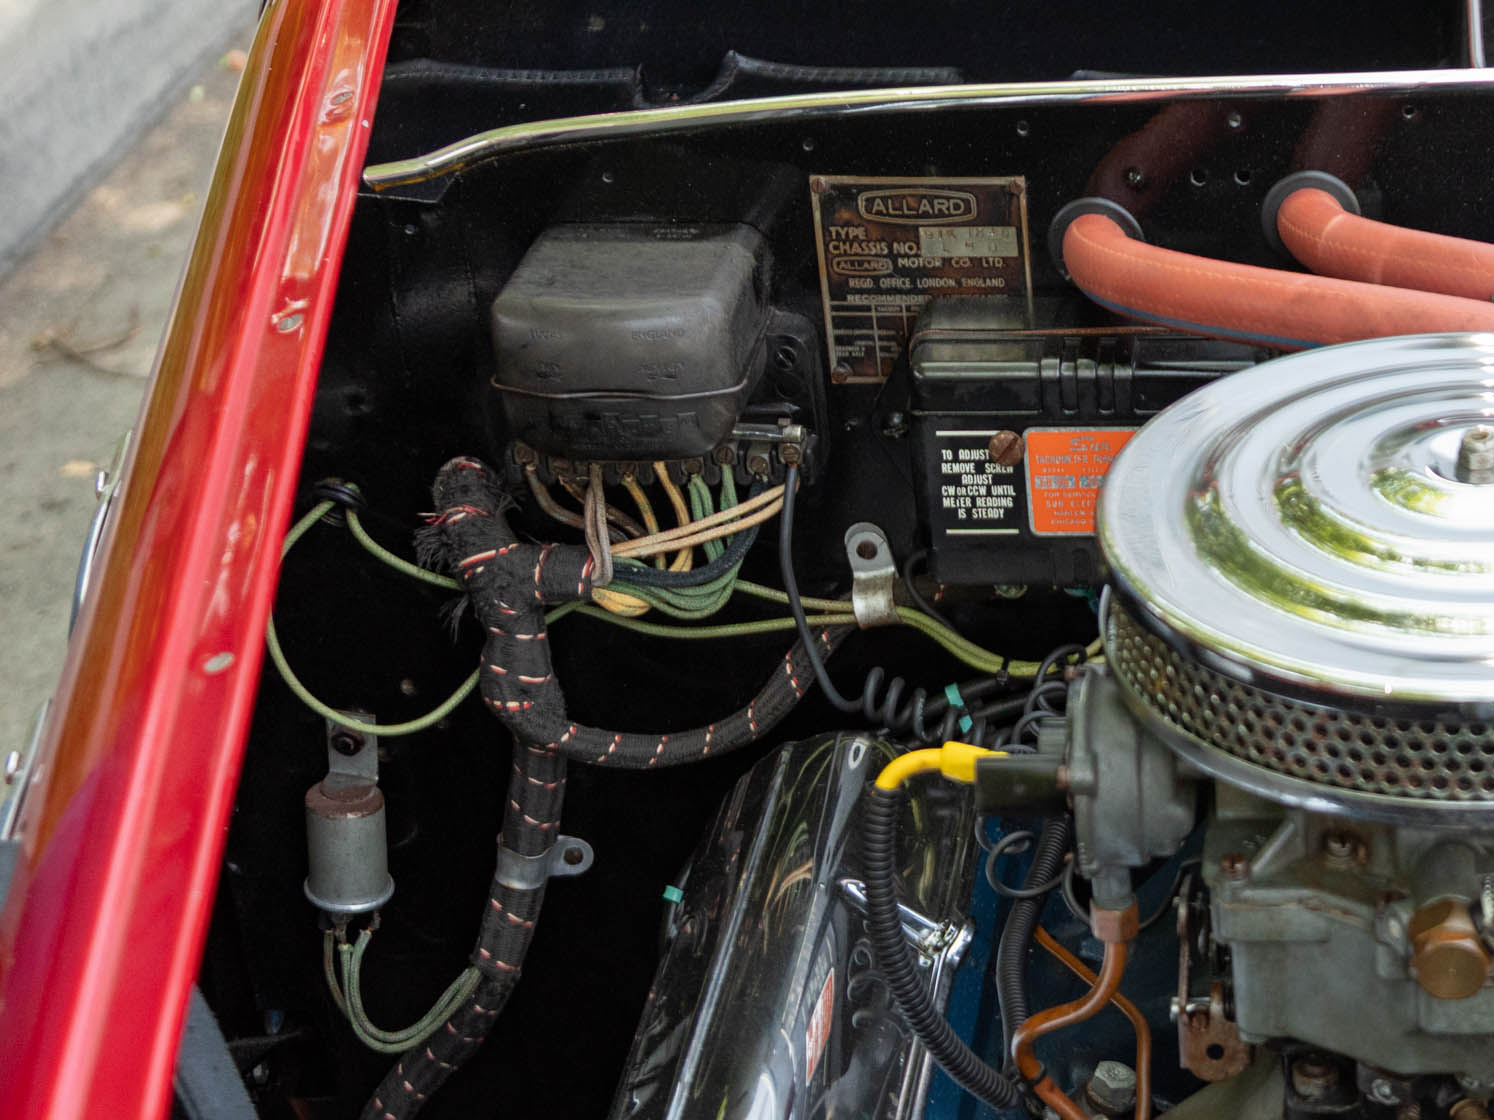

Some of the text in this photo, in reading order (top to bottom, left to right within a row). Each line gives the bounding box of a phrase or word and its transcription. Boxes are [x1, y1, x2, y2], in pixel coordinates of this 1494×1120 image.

[871, 197, 966, 216] ALLARD
[828, 226, 867, 241] TYPE
[828, 241, 889, 255] CHASSIS
[893, 242, 920, 255] NO.
[838, 260, 888, 270] ALLARD
[898, 258, 943, 269] MOTOR
[982, 258, 1006, 269] LTD.
[848, 278, 876, 289] REGD.
[962, 279, 1006, 289] ENGLAND
[941, 449, 990, 460] TO ADJUST
[941, 462, 1014, 474] REMOVE SCREW
[961, 474, 993, 485] ADJUST
[941, 485, 956, 496] CW
[967, 485, 987, 496] CCW
[991, 485, 1016, 496] UNTIL
[975, 496, 1014, 508] READING
[957, 508, 1005, 519] IS STEADY
